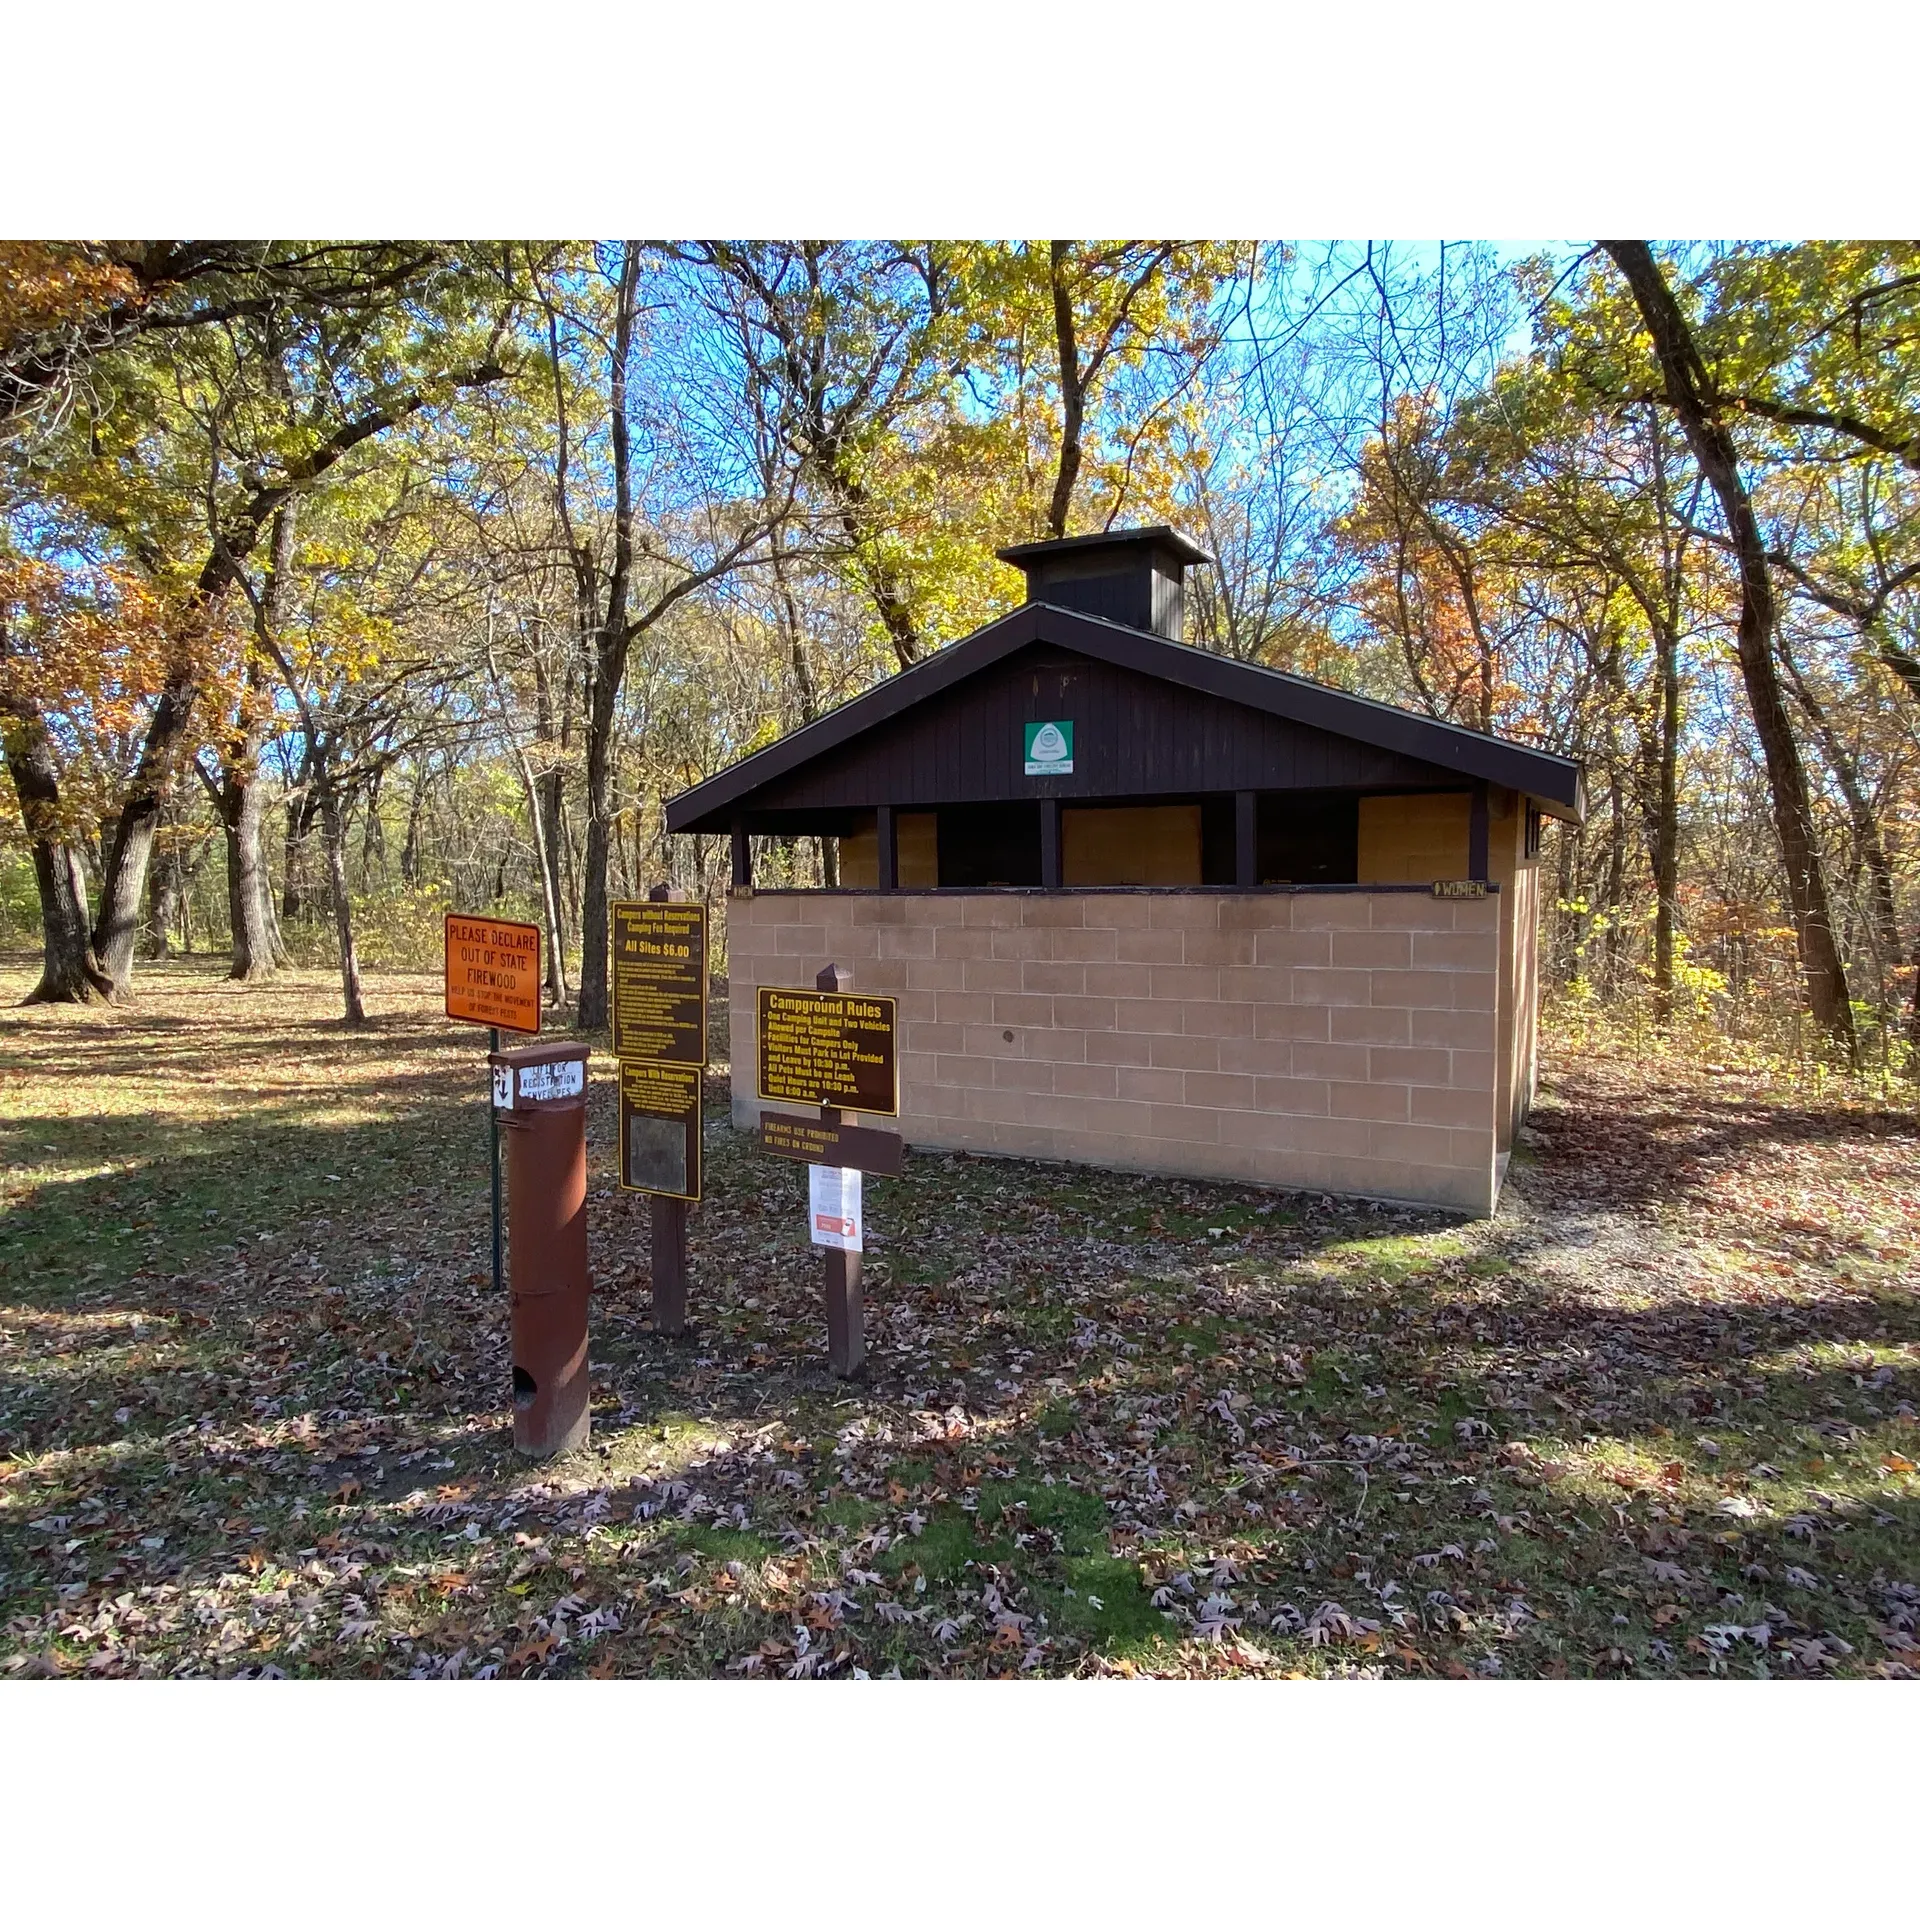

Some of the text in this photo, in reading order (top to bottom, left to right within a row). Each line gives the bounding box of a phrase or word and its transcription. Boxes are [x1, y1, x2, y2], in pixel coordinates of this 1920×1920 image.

[1442, 882, 1484, 896] WOMEN
[664, 910, 700, 922] Reservations
[627, 921, 690, 936] Camping Fee Required
[450, 925, 536, 951] PLEASE DECLARE
[625, 940, 690, 957] All Sites $6.00
[461, 947, 527, 971] OUT OF STATE
[467, 968, 516, 990] FIREWOOD
[451, 986, 466, 996] HELP
[477, 989, 491, 1000] STOP
[493, 992, 502, 1003] THE
[505, 995, 534, 1008] MOVEMENT
[769, 994, 882, 1018] Campground Rules
[469, 1003, 517, 1019] OF FOREST PESTS
[767, 1011, 890, 1032] One Camping Unit and Two Vehicles
[768, 1021, 840, 1038] Allowed per Campsite
[768, 1032, 858, 1051] Facilities for Campers Only
[768, 1042, 884, 1064] Visitors Must Park in Lot Provided
[768, 1053, 850, 1071] and Leave by 10:30 p.m.
[768, 1063, 855, 1082] All Pets Must be on Leash
[523, 1075, 576, 1089] REGISTRTION
[768, 1073, 859, 1093] Quiet Hours are 10:30 p.m.
[768, 1084, 784, 1094] Until
[802, 1089, 817, 1098] a.m.
[527, 1088, 571, 1100] ENVELPES
[764, 1121, 839, 1142] FIREARMS USE PROHIBITED
[764, 1135, 824, 1153] NO FIRES ON GROUND
